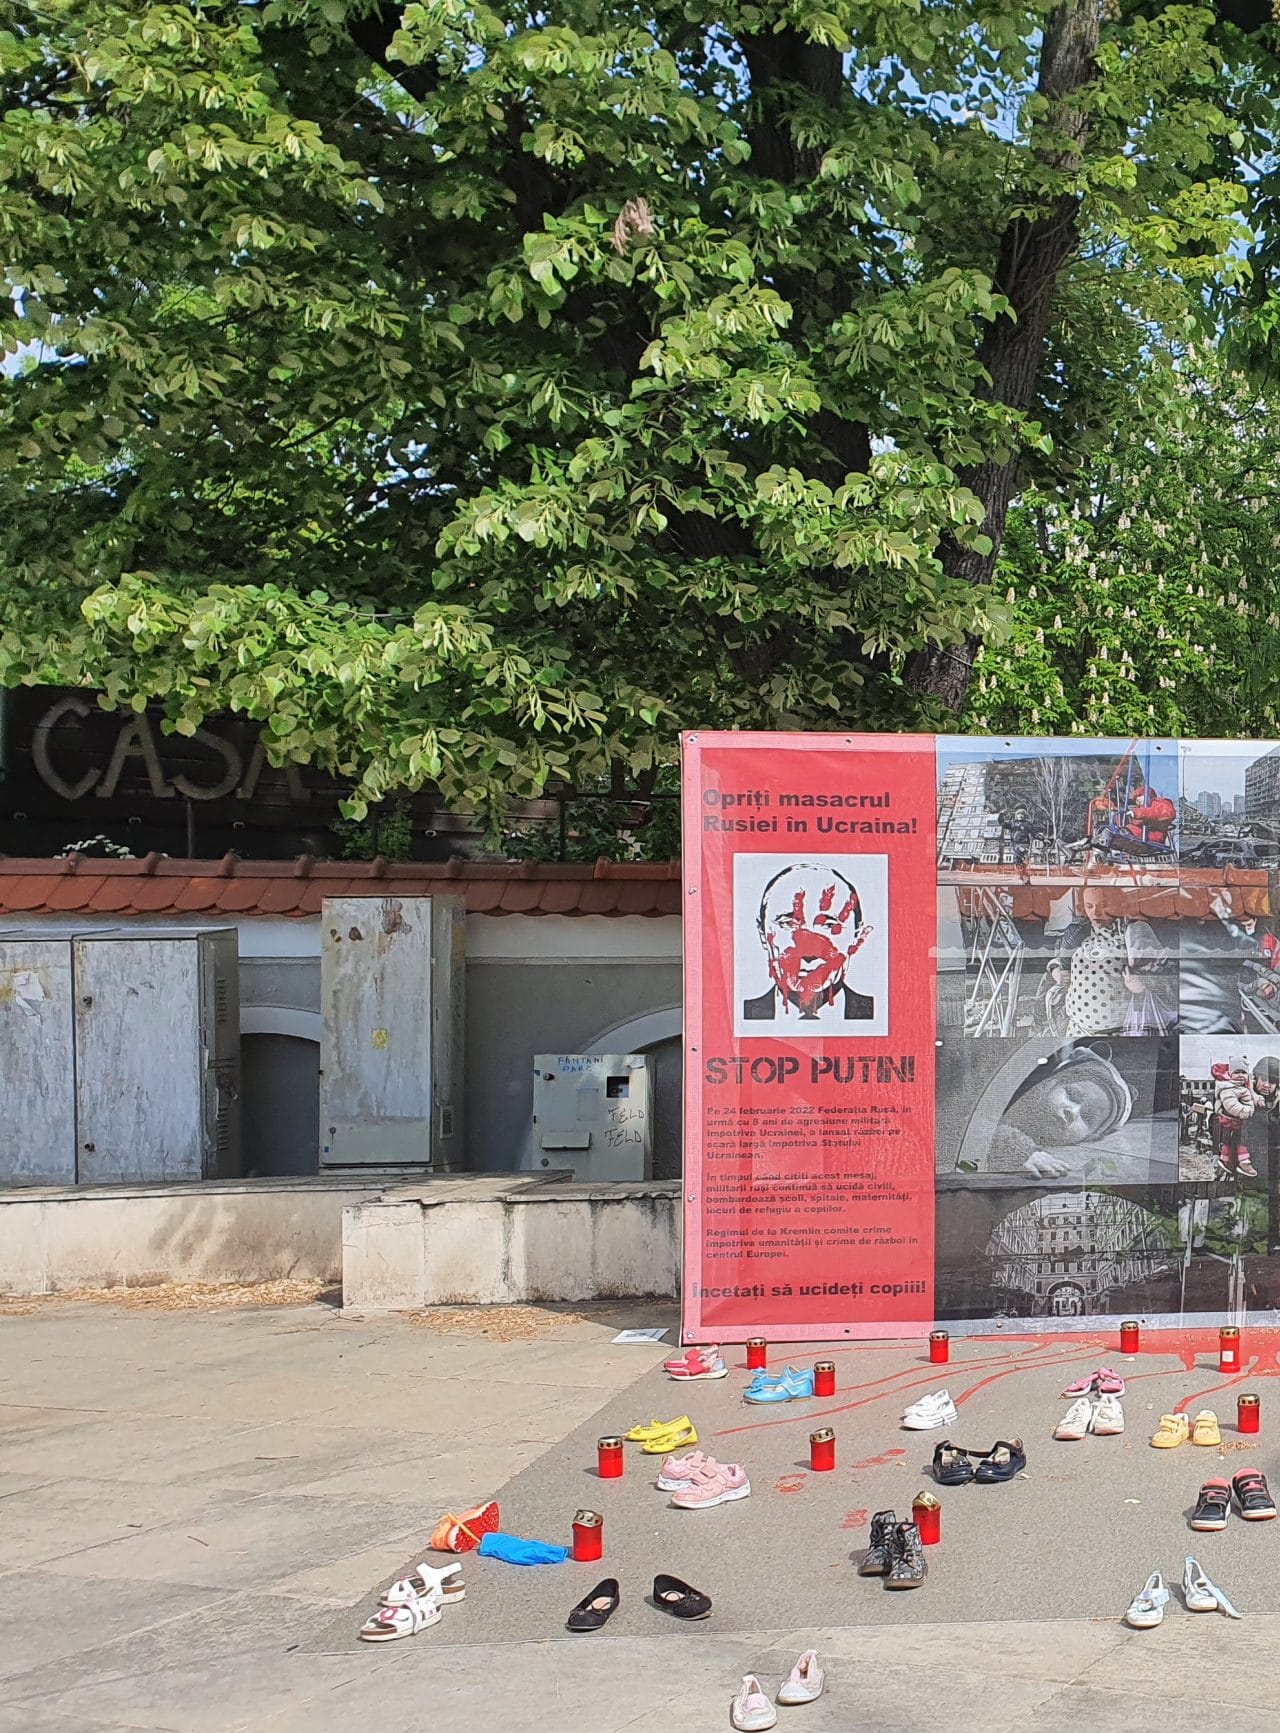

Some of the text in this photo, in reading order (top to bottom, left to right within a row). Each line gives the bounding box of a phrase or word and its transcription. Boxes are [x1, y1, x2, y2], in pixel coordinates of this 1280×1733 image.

[703, 789, 890, 812] Opriți masacrul
[703, 815, 918, 834] Rusiei în Ucraina!
[705, 1055, 915, 1084] STOP PUTIN!
[740, 1107, 786, 1115] februarie
[790, 1106, 815, 1114] 2022
[818, 1106, 867, 1115] Federația
[762, 1118, 778, 1126] ani
[720, 1173, 753, 1182] timpul
[811, 1172, 841, 1180] acest
[739, 1206, 752, 1214] de
[755, 1206, 792, 1215] refugiu
[706, 1226, 892, 1238] Regimul de la Kremlin comite crime
[826, 1238, 856, 1246] crime
[858, 1237, 872, 1245] de
[706, 1250, 789, 1259] centrul Europei.
[771, 1283, 793, 1297] să
[799, 1281, 864, 1299] ucideți
[870, 1280, 926, 1298] copiii!
